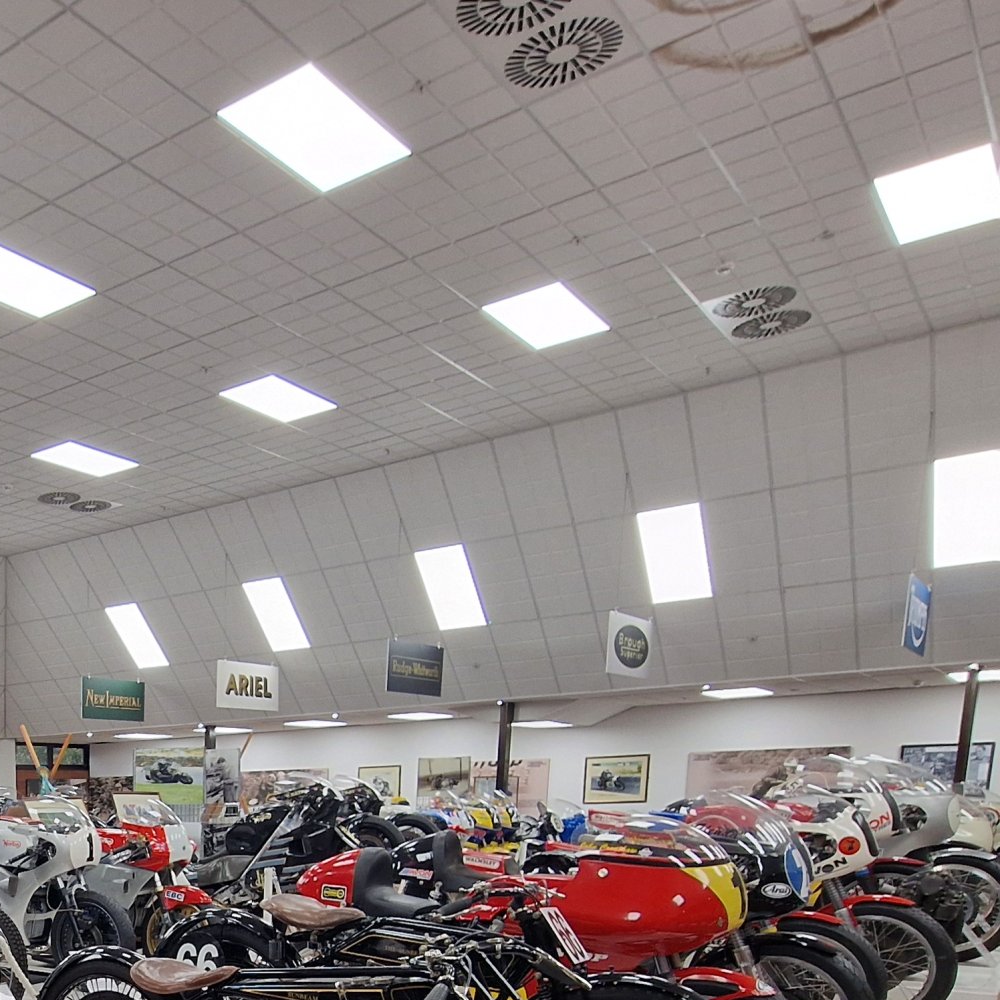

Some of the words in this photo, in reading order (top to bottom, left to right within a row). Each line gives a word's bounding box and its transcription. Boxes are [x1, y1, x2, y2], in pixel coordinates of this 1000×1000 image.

[619, 632, 645, 649] Brough
[225, 673, 273, 698] ARIEL
[86, 833, 94, 862] 1
[166, 890, 183, 900] EBC
[766, 885, 788, 894] Arai
[176, 942, 219, 971] 66
